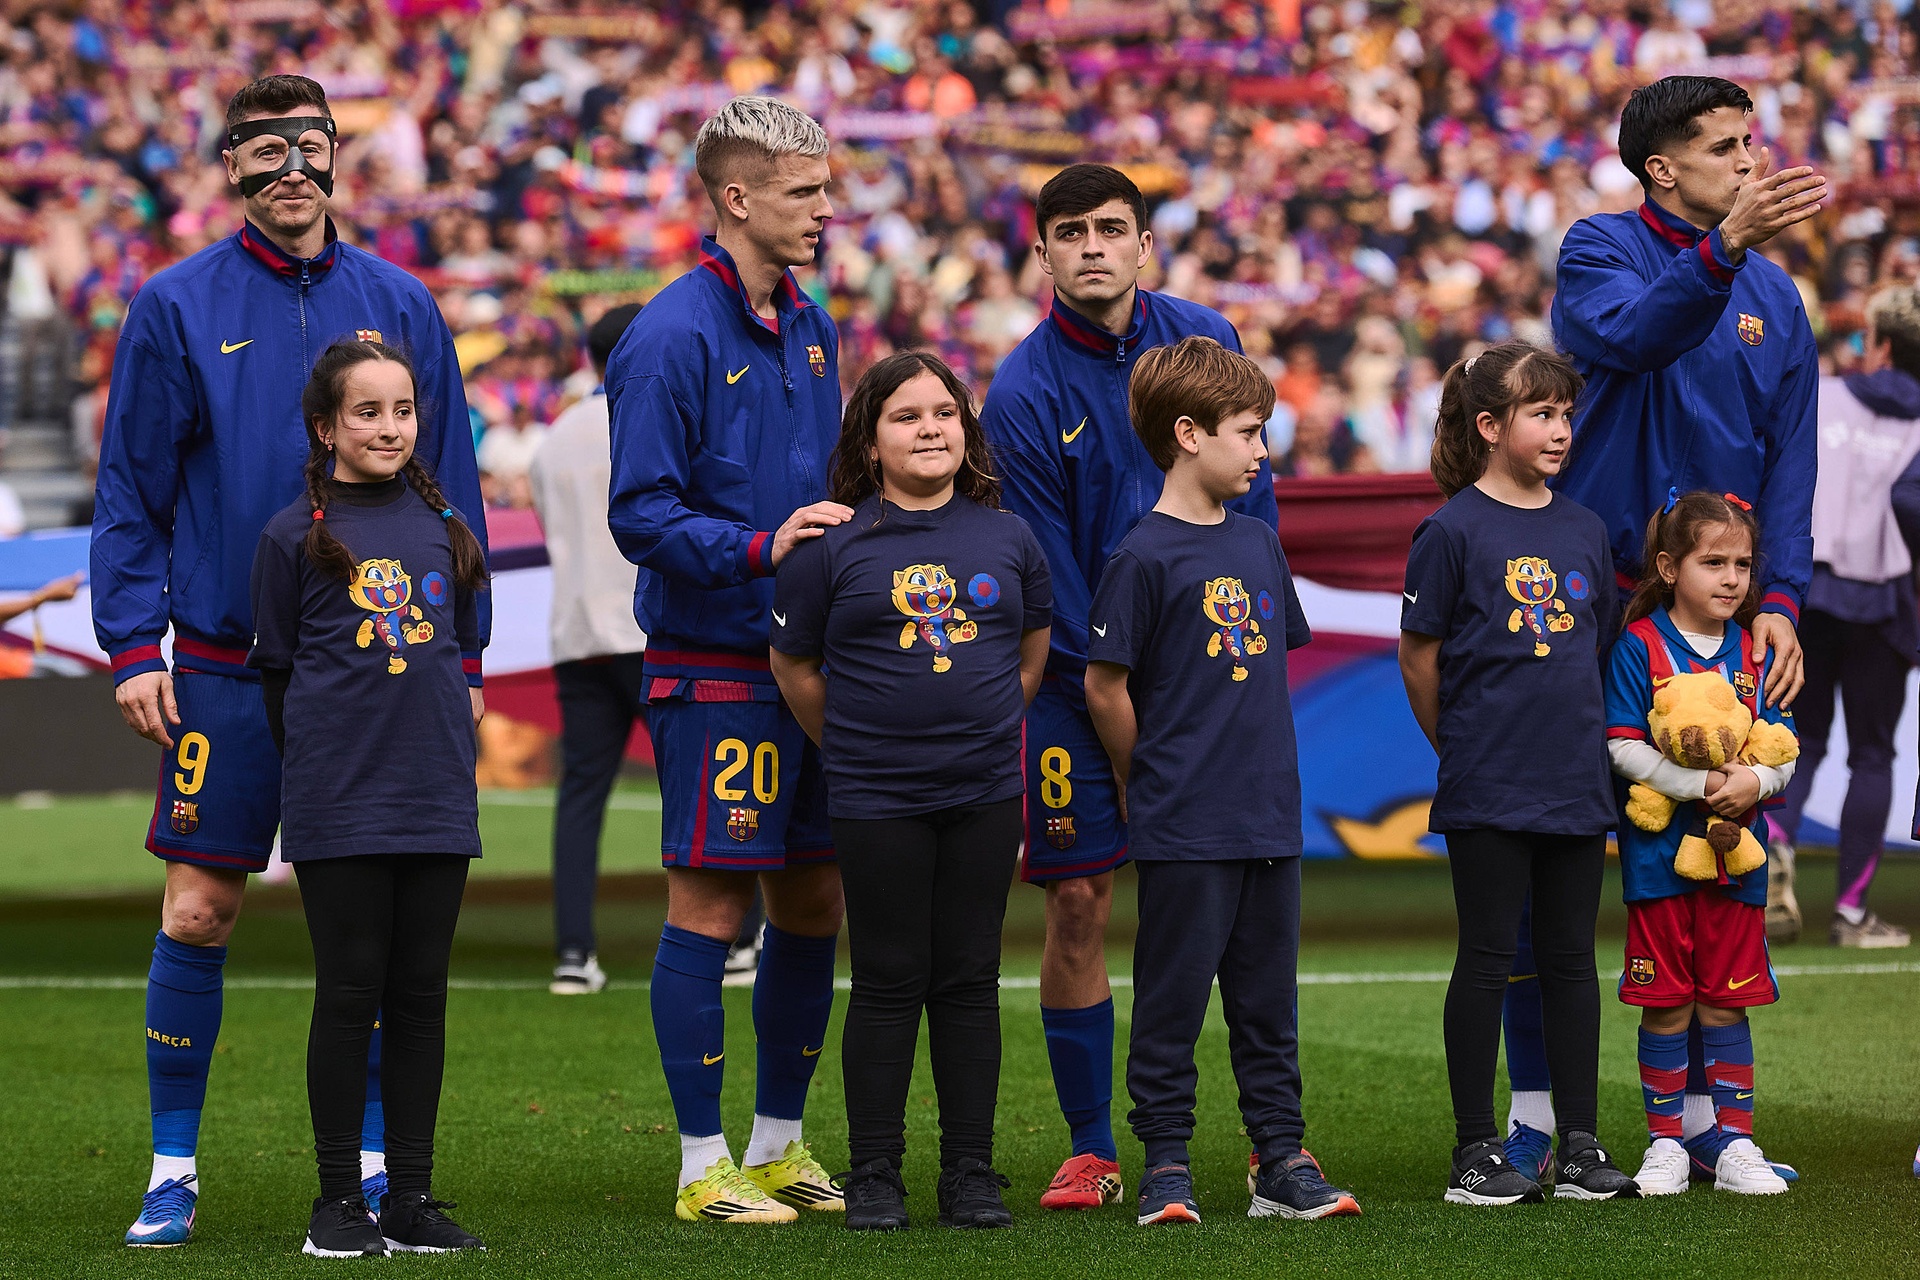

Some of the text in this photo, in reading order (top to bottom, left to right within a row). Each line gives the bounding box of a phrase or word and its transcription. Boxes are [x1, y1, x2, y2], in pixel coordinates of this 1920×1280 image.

[175, 731, 210, 795] 9
[714, 738, 779, 804] 20
[1040, 746, 1072, 809] 8
[147, 1027, 191, 1047] BARÇA
[1460, 1168, 1487, 1191] N
[1563, 1163, 1582, 1179] N
